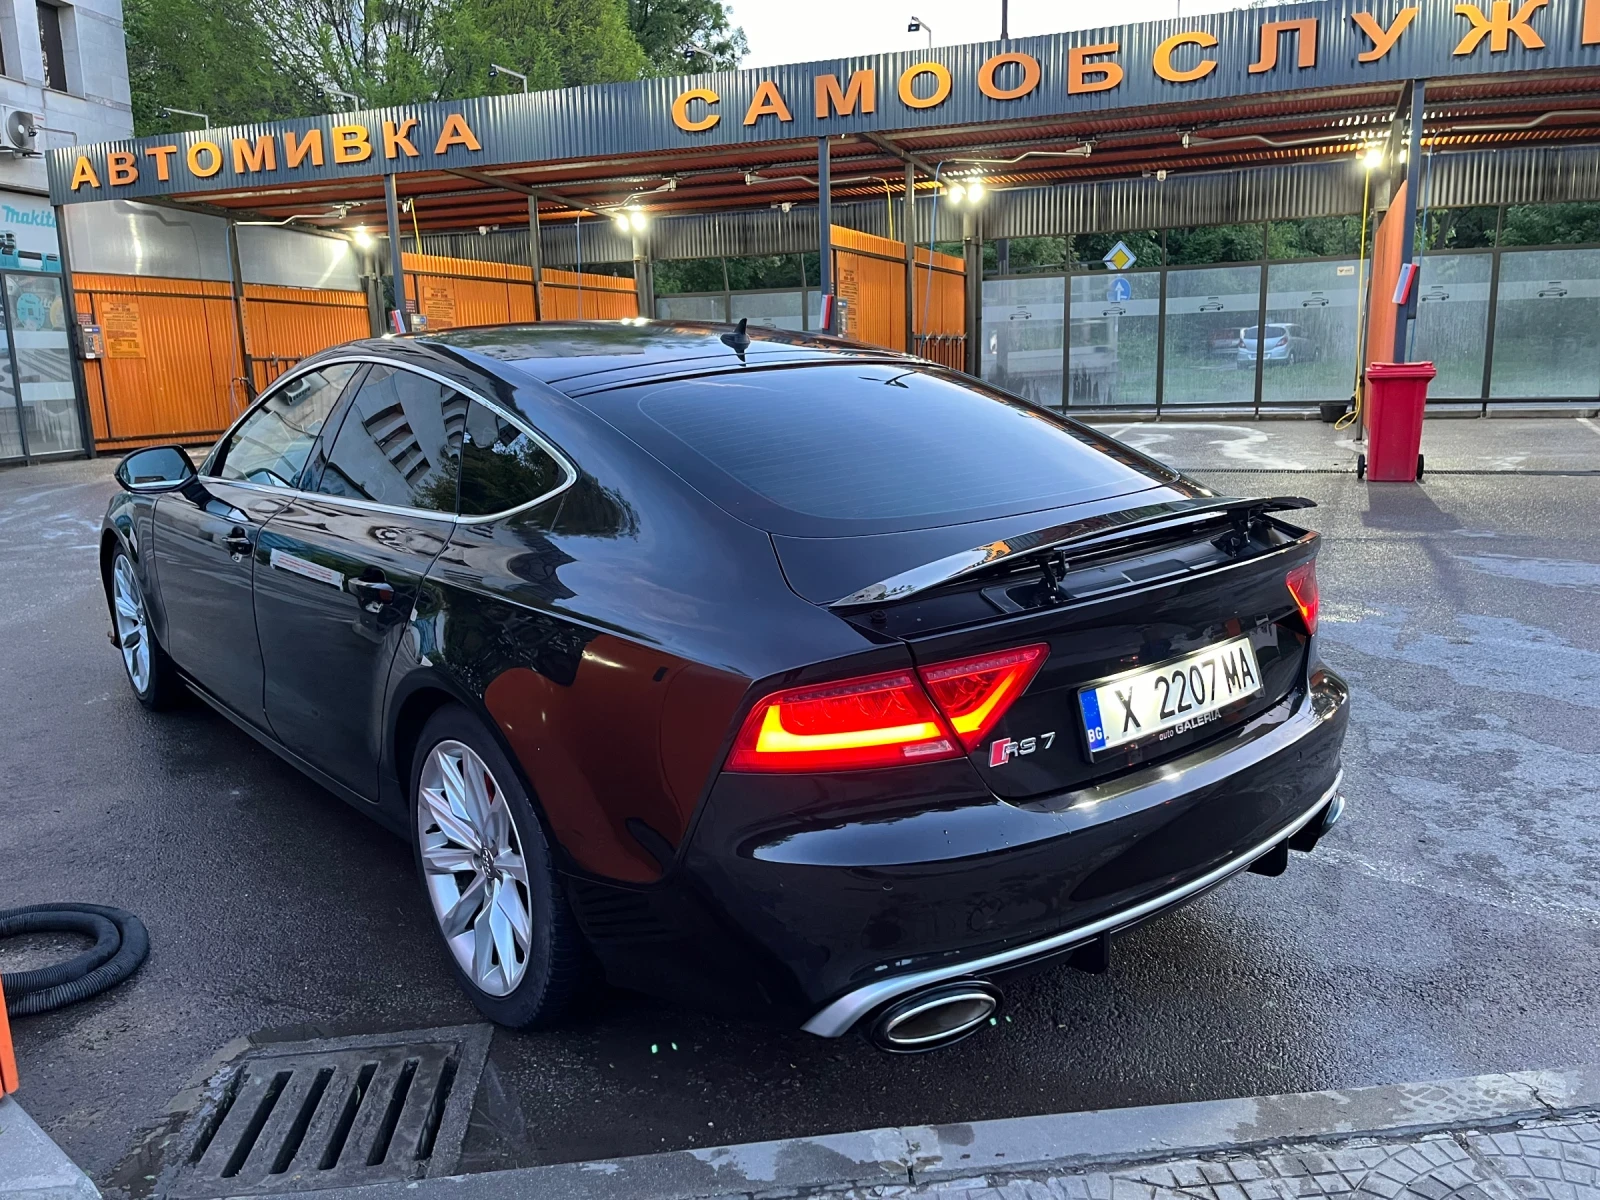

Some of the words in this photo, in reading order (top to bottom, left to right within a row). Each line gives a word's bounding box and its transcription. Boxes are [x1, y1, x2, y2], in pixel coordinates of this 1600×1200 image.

[70, 112, 482, 191] АВТОМИВКА
[671, 0, 1600, 133] САМООБСЛУЖ
[1154, 658, 1216, 721] 2207
[1221, 647, 1254, 694] MA
[1087, 728, 1103, 743] BG
[1158, 729, 1174, 741] auto
[1175, 709, 1222, 735] GALERIA
